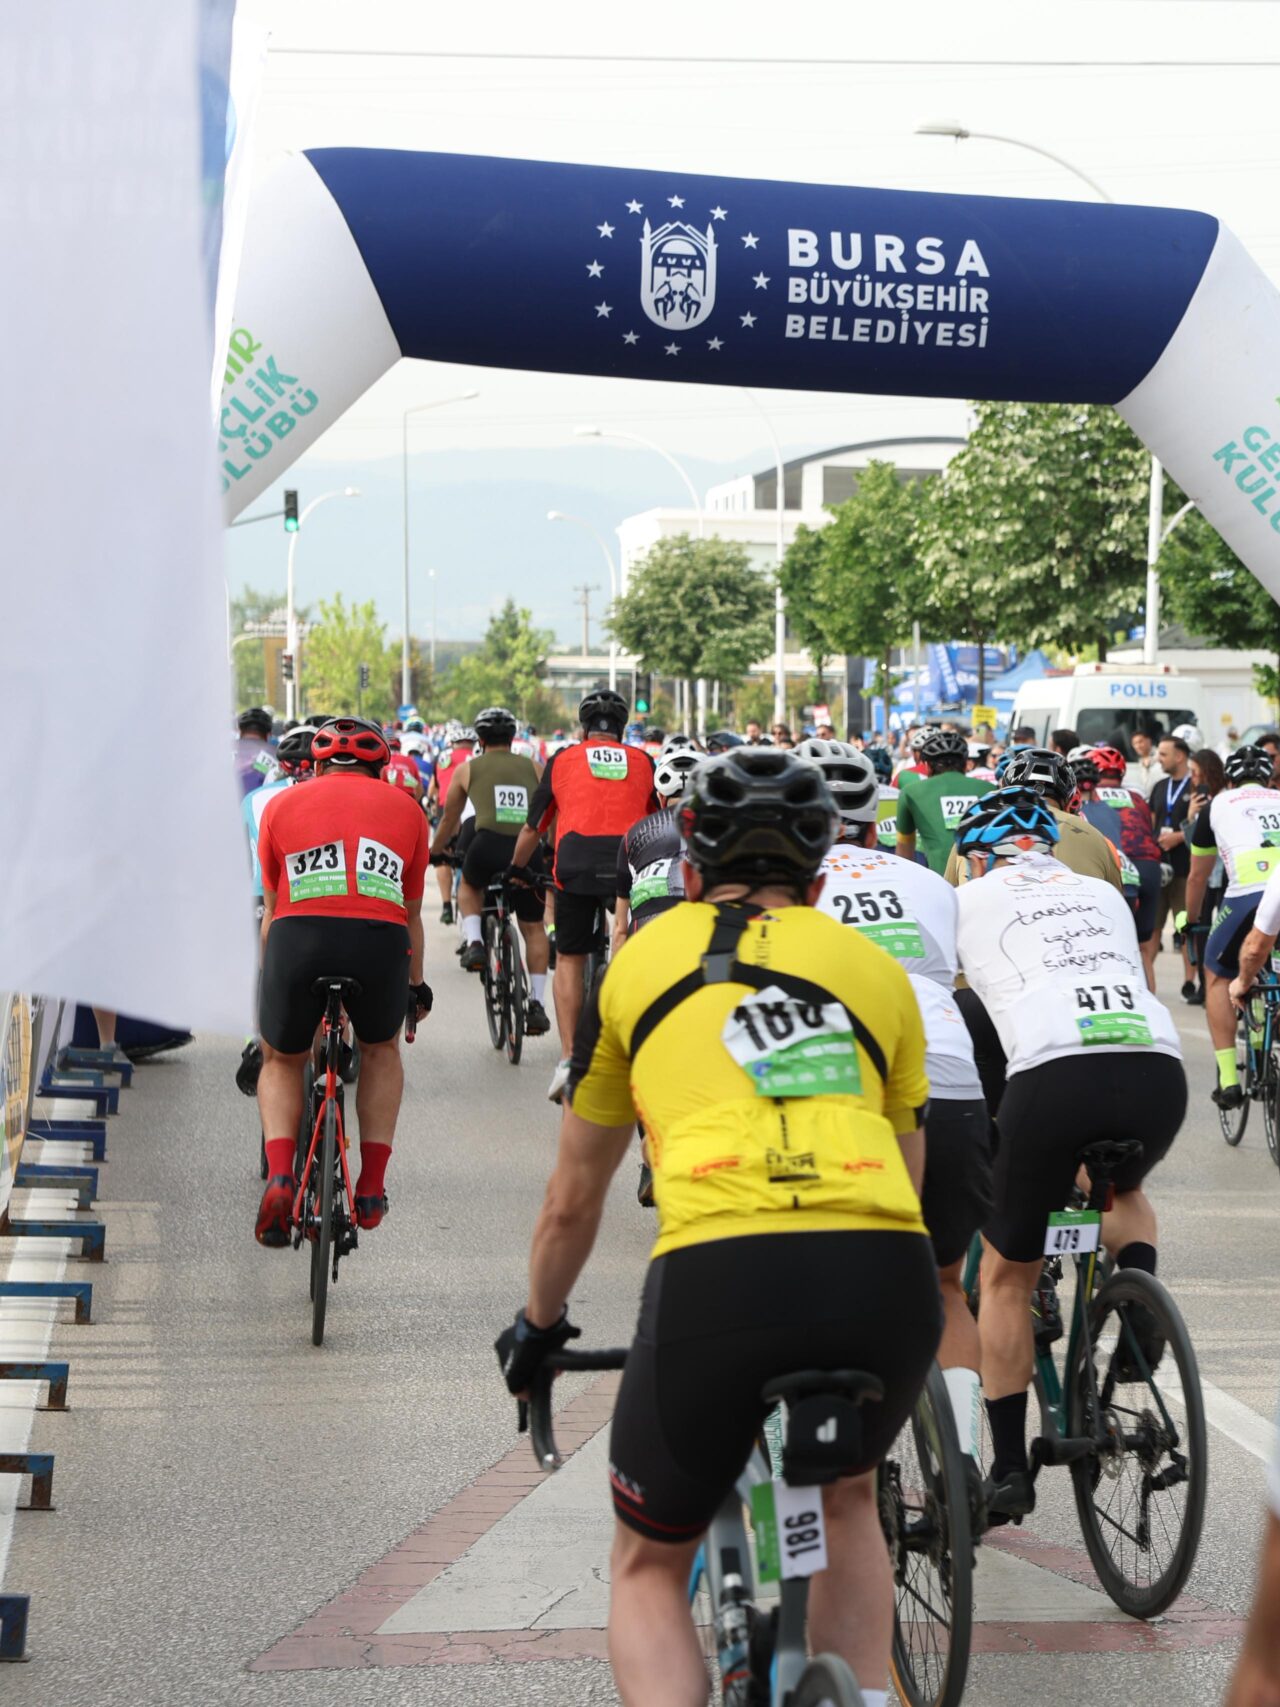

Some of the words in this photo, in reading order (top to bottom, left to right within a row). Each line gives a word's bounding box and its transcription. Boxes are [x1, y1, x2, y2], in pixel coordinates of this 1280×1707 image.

[788, 229, 990, 277] BURSA
[788, 271, 989, 313] BÜYÜKŞEHİR
[785, 316, 989, 347] BELEDİYESİ
[220, 387, 318, 495] LÜBÜ
[1110, 682, 1168, 698] POLİS
[593, 750, 622, 763] 455
[499, 792, 524, 807] 292
[946, 801, 974, 815] 22
[294, 844, 338, 875] 323
[833, 890, 904, 924] 253
[1075, 985, 1136, 1012] 479
[785, 1510, 821, 1560] 186
